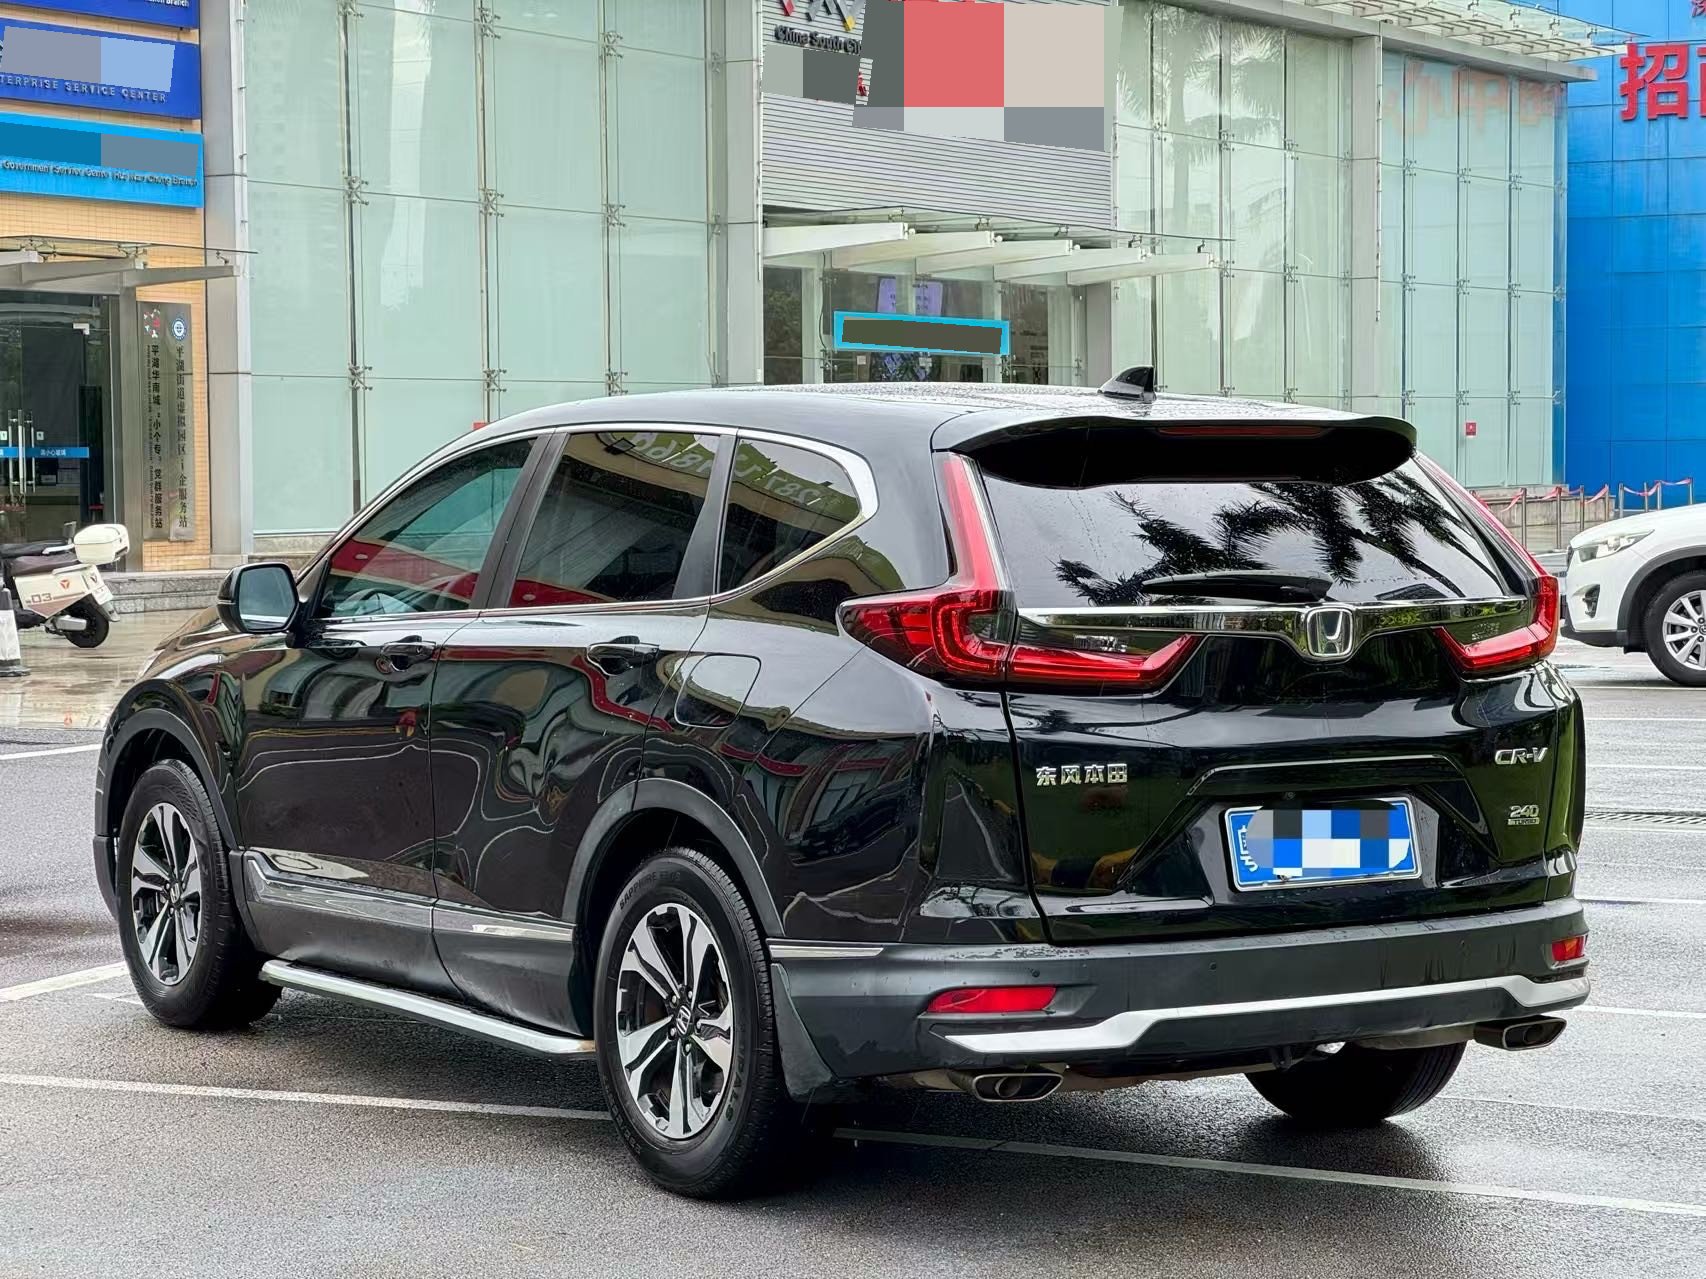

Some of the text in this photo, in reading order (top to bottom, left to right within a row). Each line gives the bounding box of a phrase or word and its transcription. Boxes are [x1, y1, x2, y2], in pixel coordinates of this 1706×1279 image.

[775, 25, 808, 44] China
[809, 31, 843, 50] South
[65, 81, 115, 96] SERVICE
[121, 88, 166, 103] CENTER
[1495, 747, 1548, 764] CR-V
[1036, 763, 1127, 786] 东风本田
[1510, 805, 1539, 817] 240
